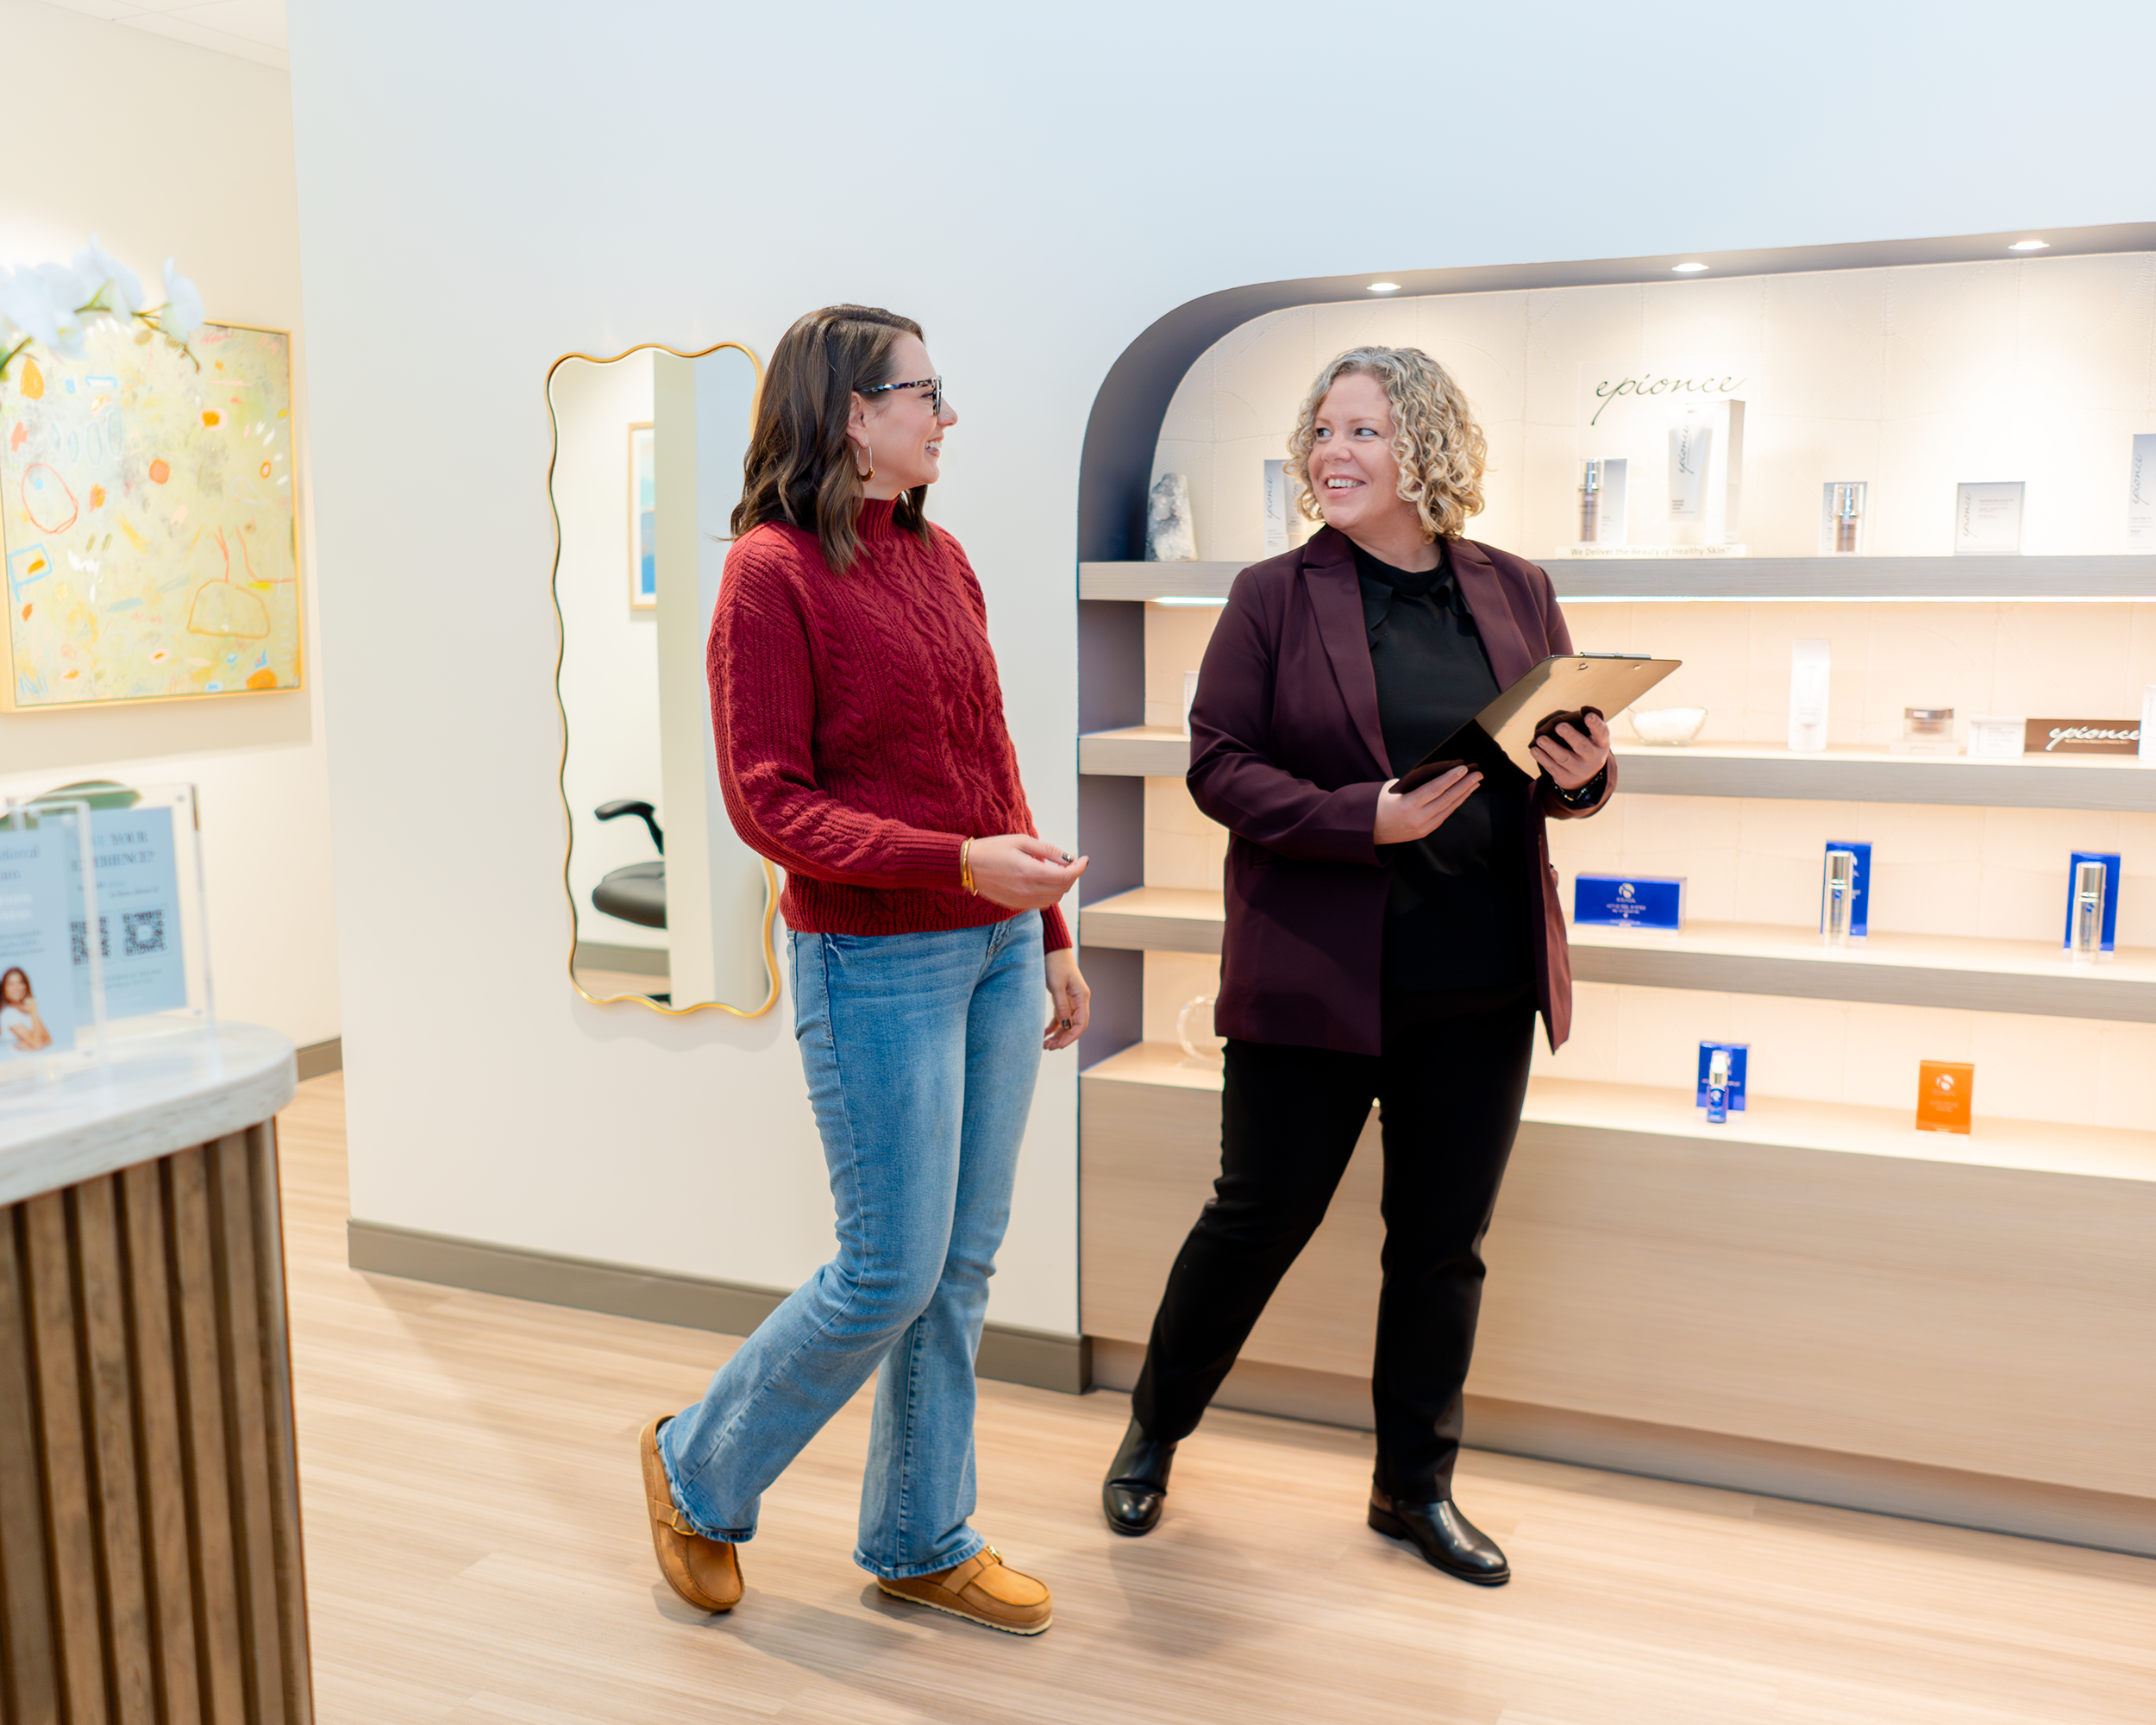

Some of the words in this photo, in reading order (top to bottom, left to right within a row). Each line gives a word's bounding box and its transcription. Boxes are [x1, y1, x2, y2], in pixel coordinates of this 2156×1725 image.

[1591, 373, 1746, 425] epionce
[1677, 424, 1695, 474] epionce
[1265, 474, 1280, 520] epionce
[2131, 453, 2150, 505] epionce
[1963, 490, 1977, 537] epionce
[1570, 548, 1583, 556] We
[1585, 548, 1614, 556] Deliver
[1615, 547, 1629, 555] the
[1632, 548, 1659, 557] Beauty
[1662, 547, 1671, 556] of
[1672, 547, 1704, 556] Healthy
[2045, 725, 2140, 751] epionce
